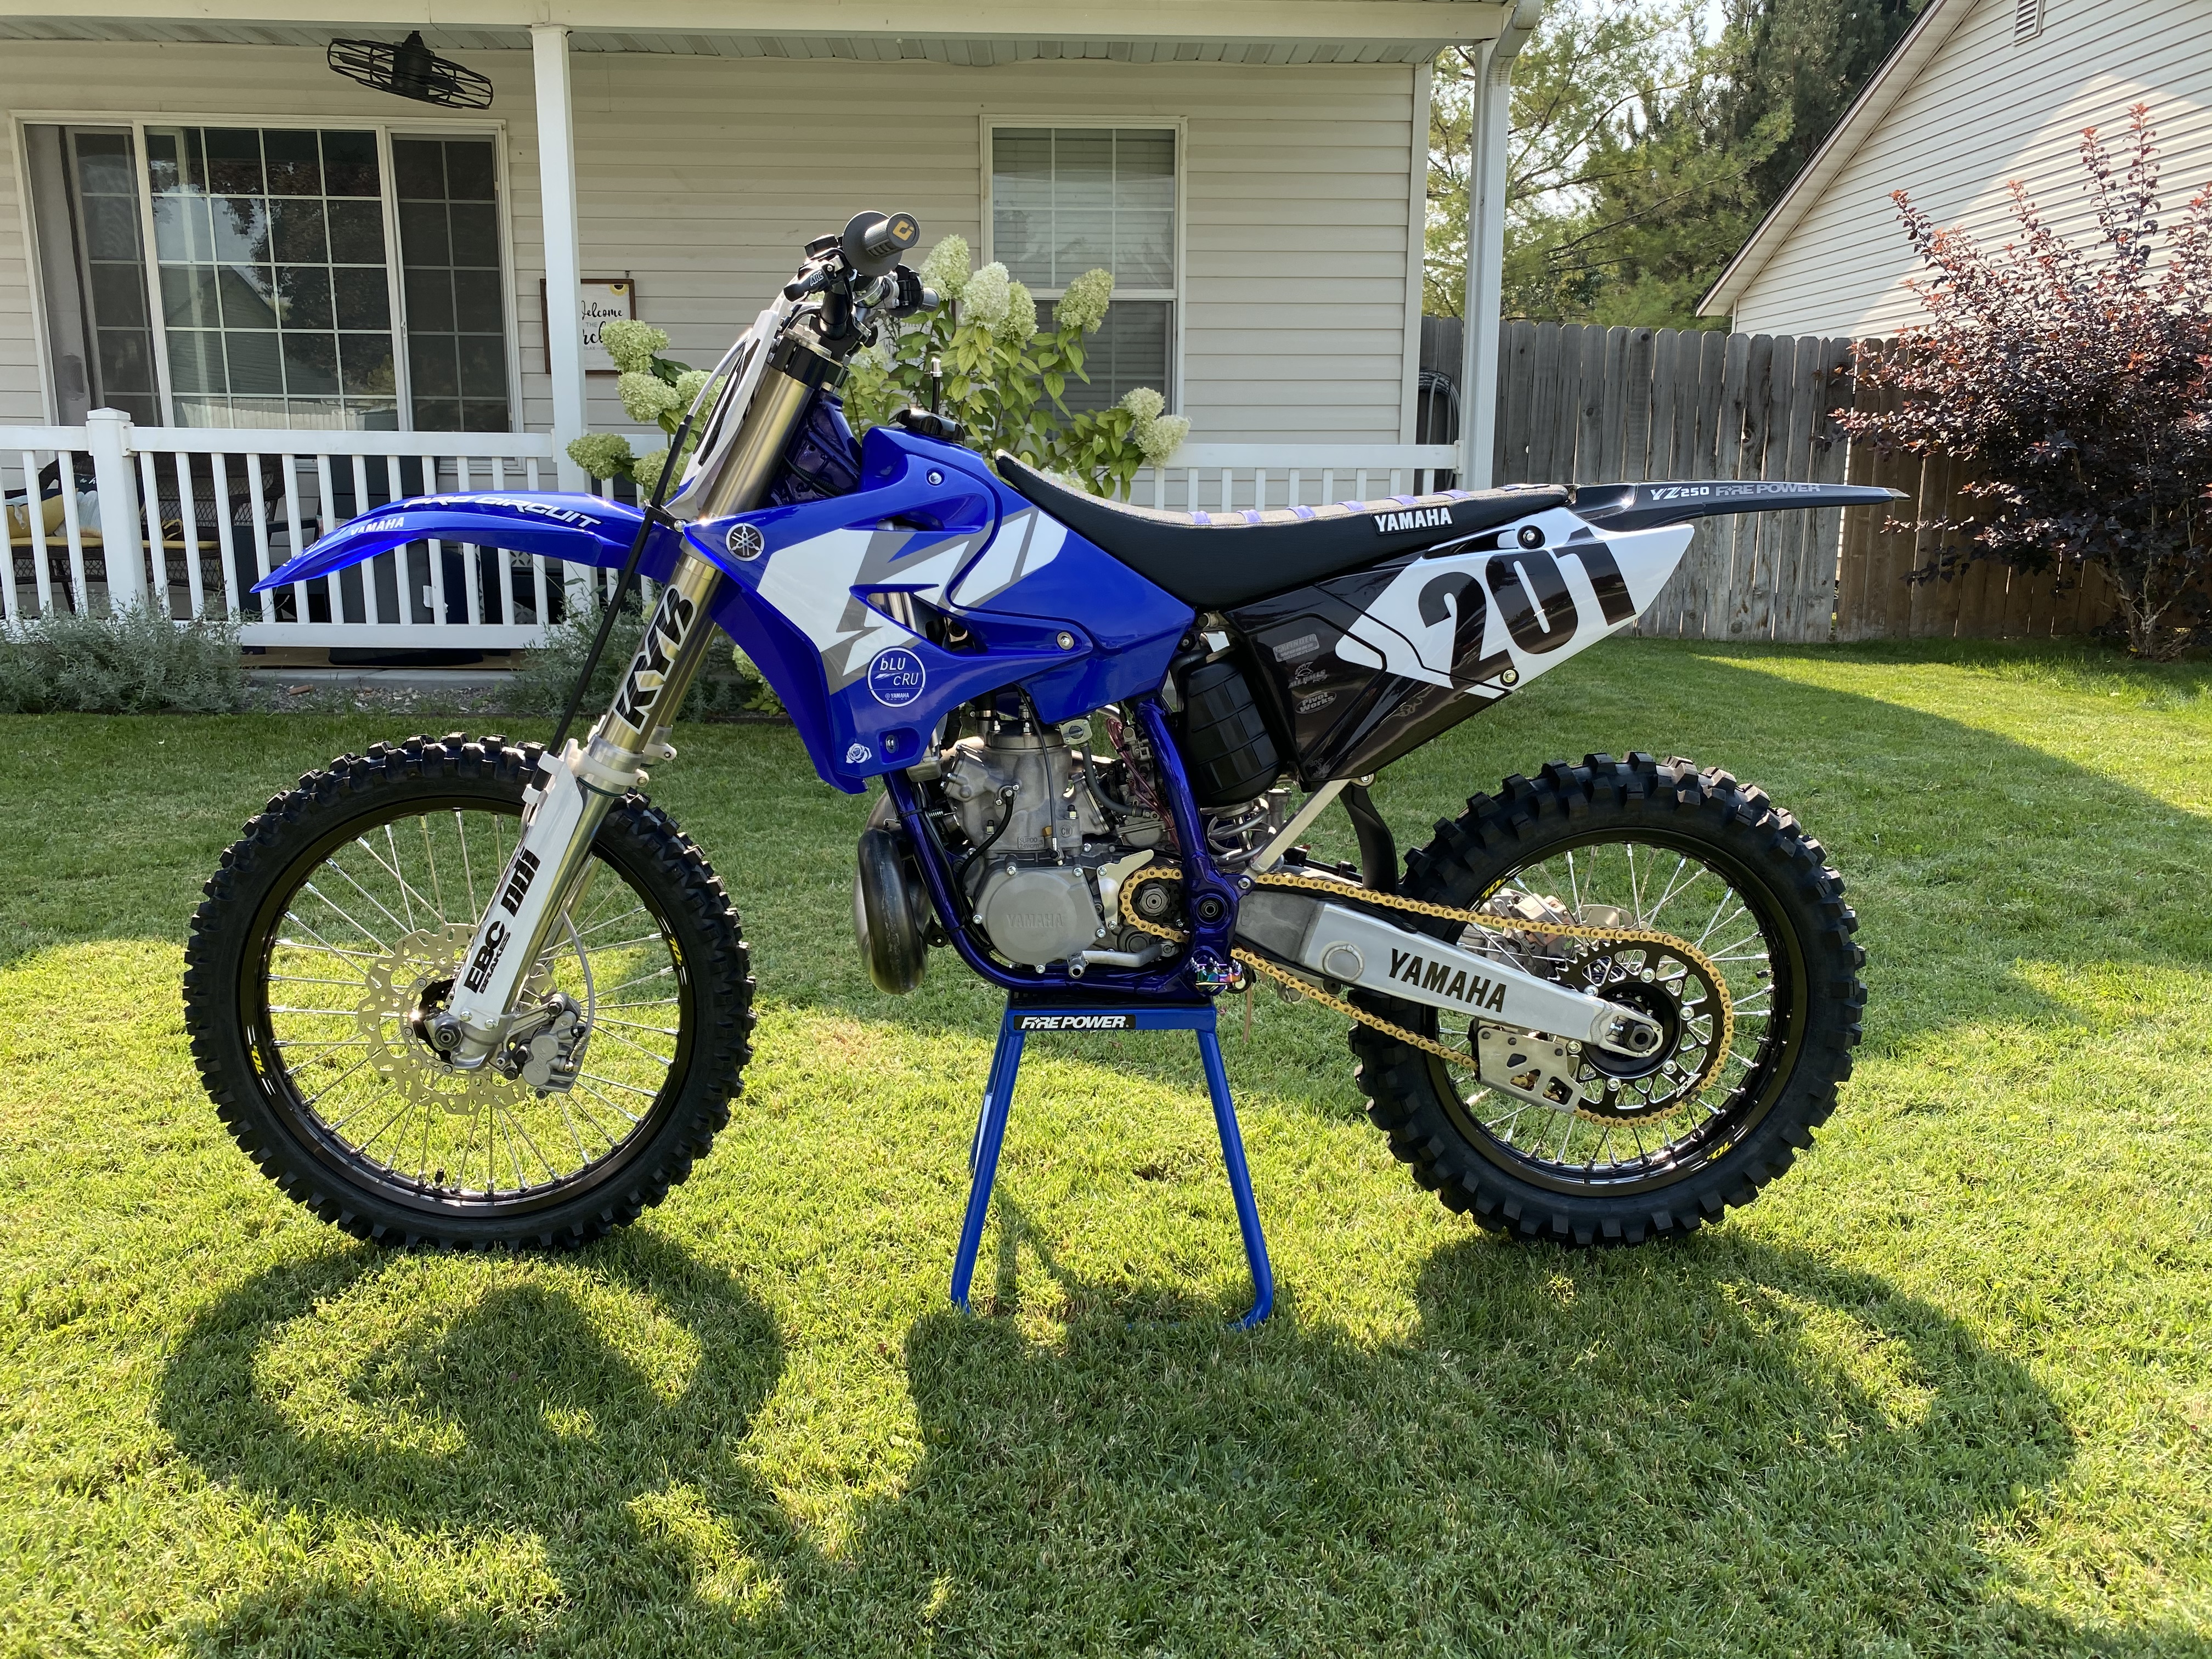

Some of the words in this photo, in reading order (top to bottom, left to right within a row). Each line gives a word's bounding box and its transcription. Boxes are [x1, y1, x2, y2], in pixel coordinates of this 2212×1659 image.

[1650, 486, 1709, 500] YZ250
[1756, 484, 1820, 494] POWER
[403, 496, 476, 509] PRO
[475, 496, 601, 528] CIRCUIT
[1374, 506, 1453, 533] YAMAHA
[351, 517, 405, 535] YAMAHA
[1418, 527, 1636, 680] 201
[612, 585, 697, 735] KYB
[1299, 696, 1334, 713] Works
[1302, 692, 1329, 706] Pivot
[1061, 827, 1070, 836] CW
[1006, 913, 1063, 928] YAMAHA
[464, 921, 505, 994] EBC
[479, 932, 511, 994] BRAKES
[1389, 948, 1507, 1014] YAMAHA
[1061, 1015, 1126, 1029] POWER
